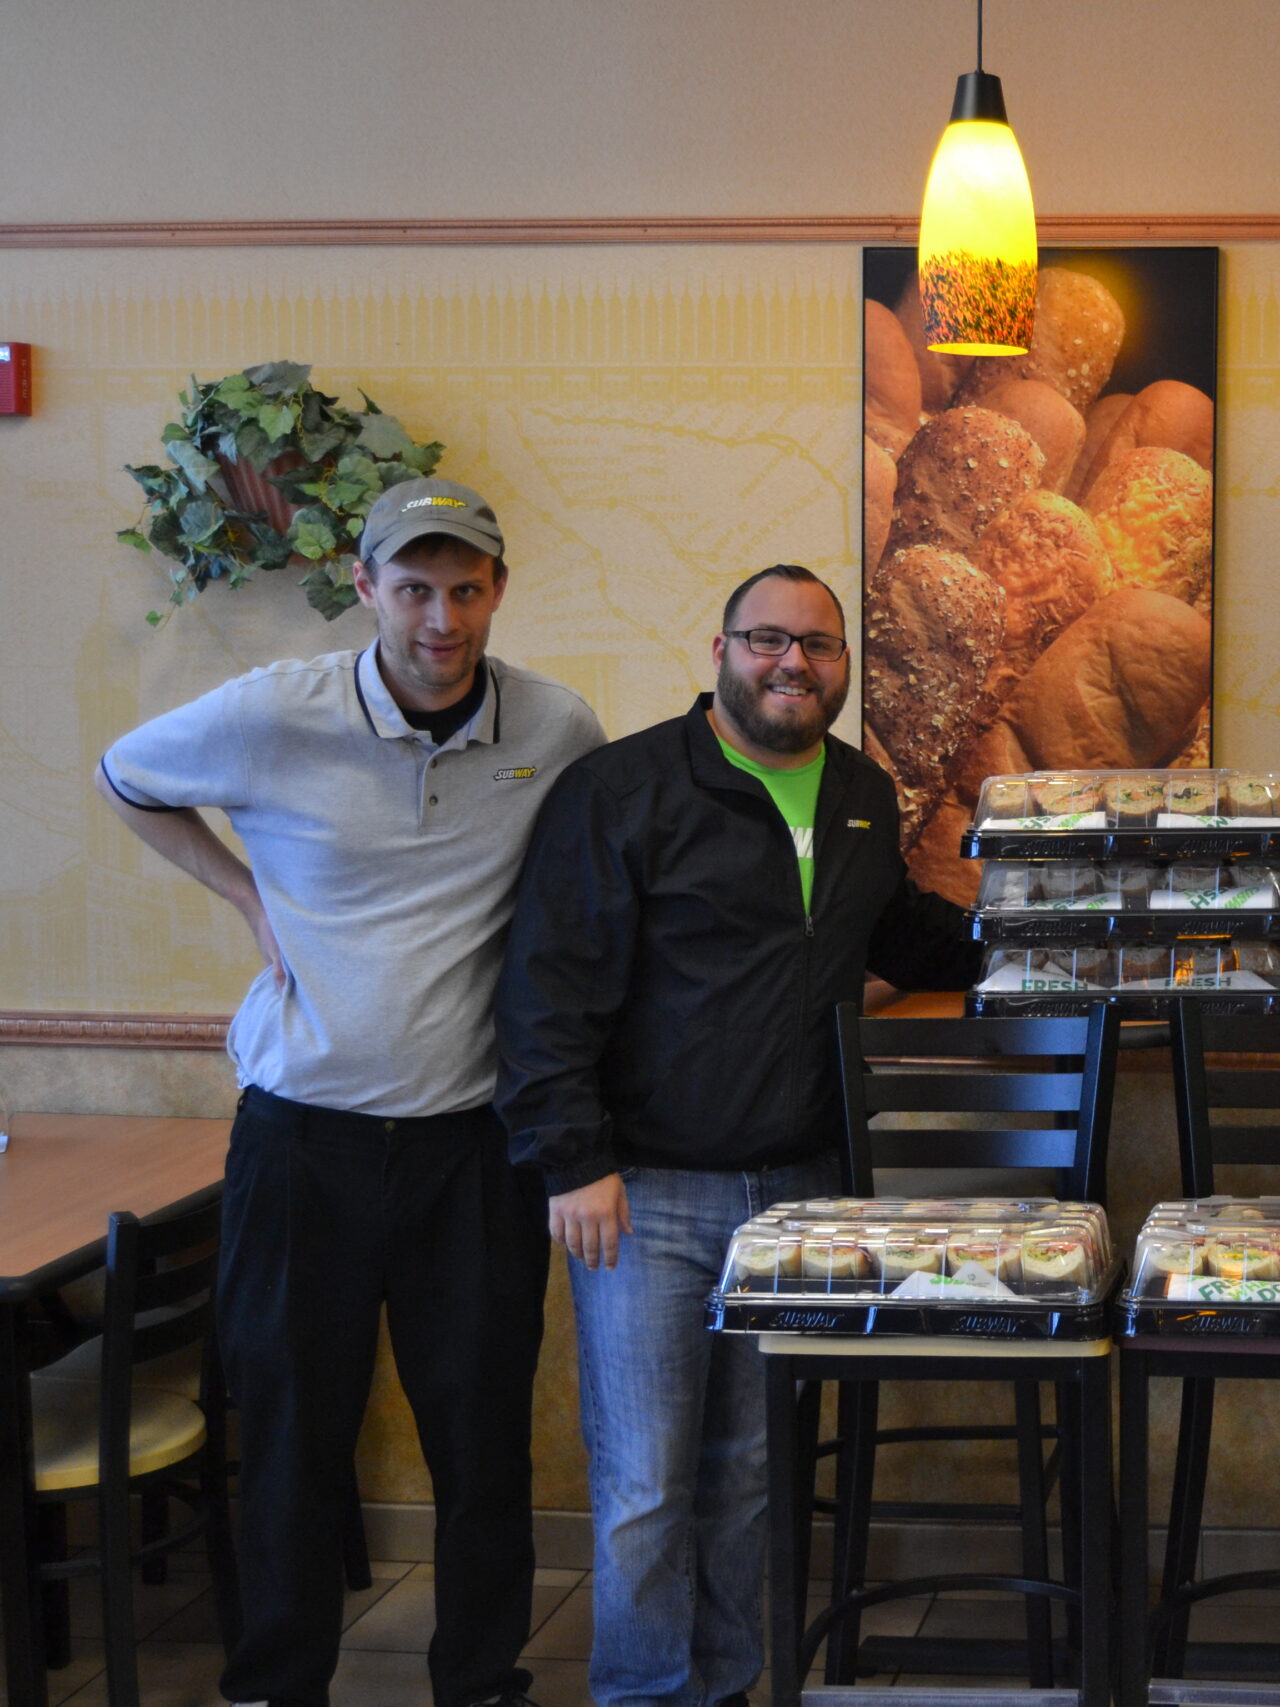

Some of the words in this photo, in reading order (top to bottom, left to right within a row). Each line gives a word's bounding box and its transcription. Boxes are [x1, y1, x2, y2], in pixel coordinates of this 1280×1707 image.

[401, 496, 469, 513] SUBWAY
[493, 766, 537, 781] SUBWAY
[1021, 979, 1088, 992] FRESH
